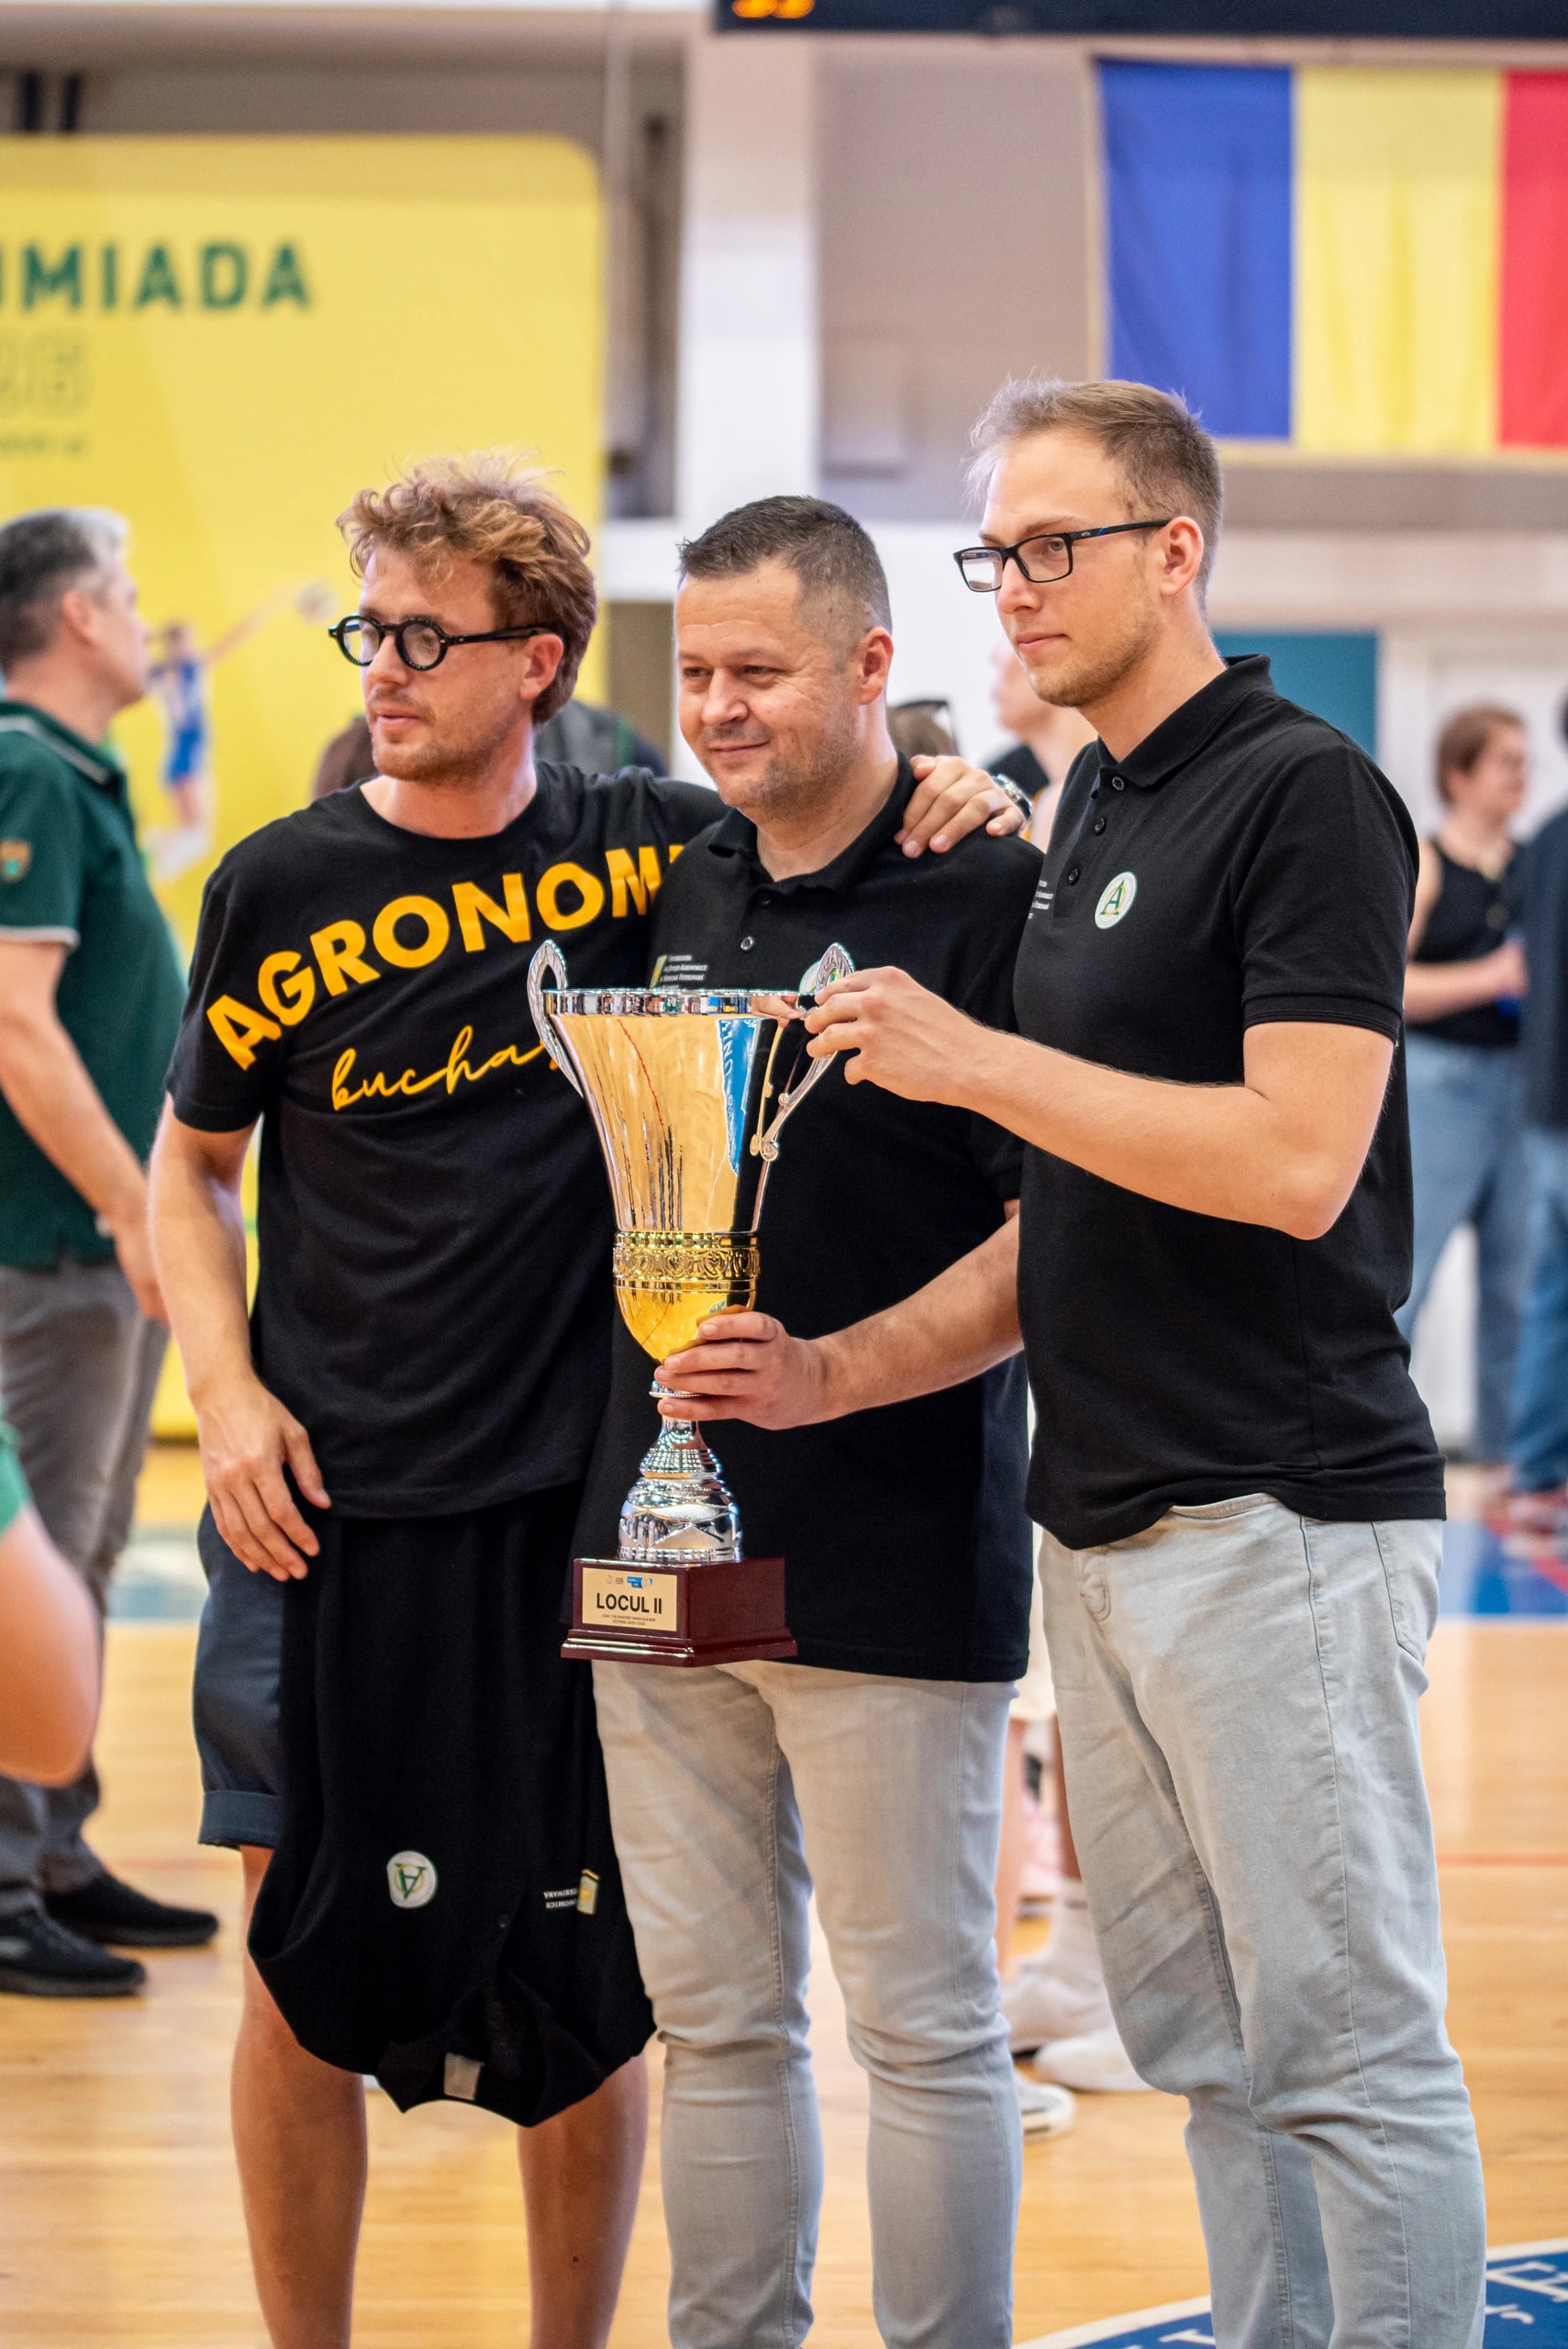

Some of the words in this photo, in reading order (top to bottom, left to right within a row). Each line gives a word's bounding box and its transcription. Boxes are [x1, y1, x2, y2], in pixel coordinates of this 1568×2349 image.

[0, 241, 312, 312] MIADA
[206, 844, 685, 1072] AGRONOM
[332, 1025, 559, 1111] bucha
[596, 1593, 650, 1613] LOCUL
